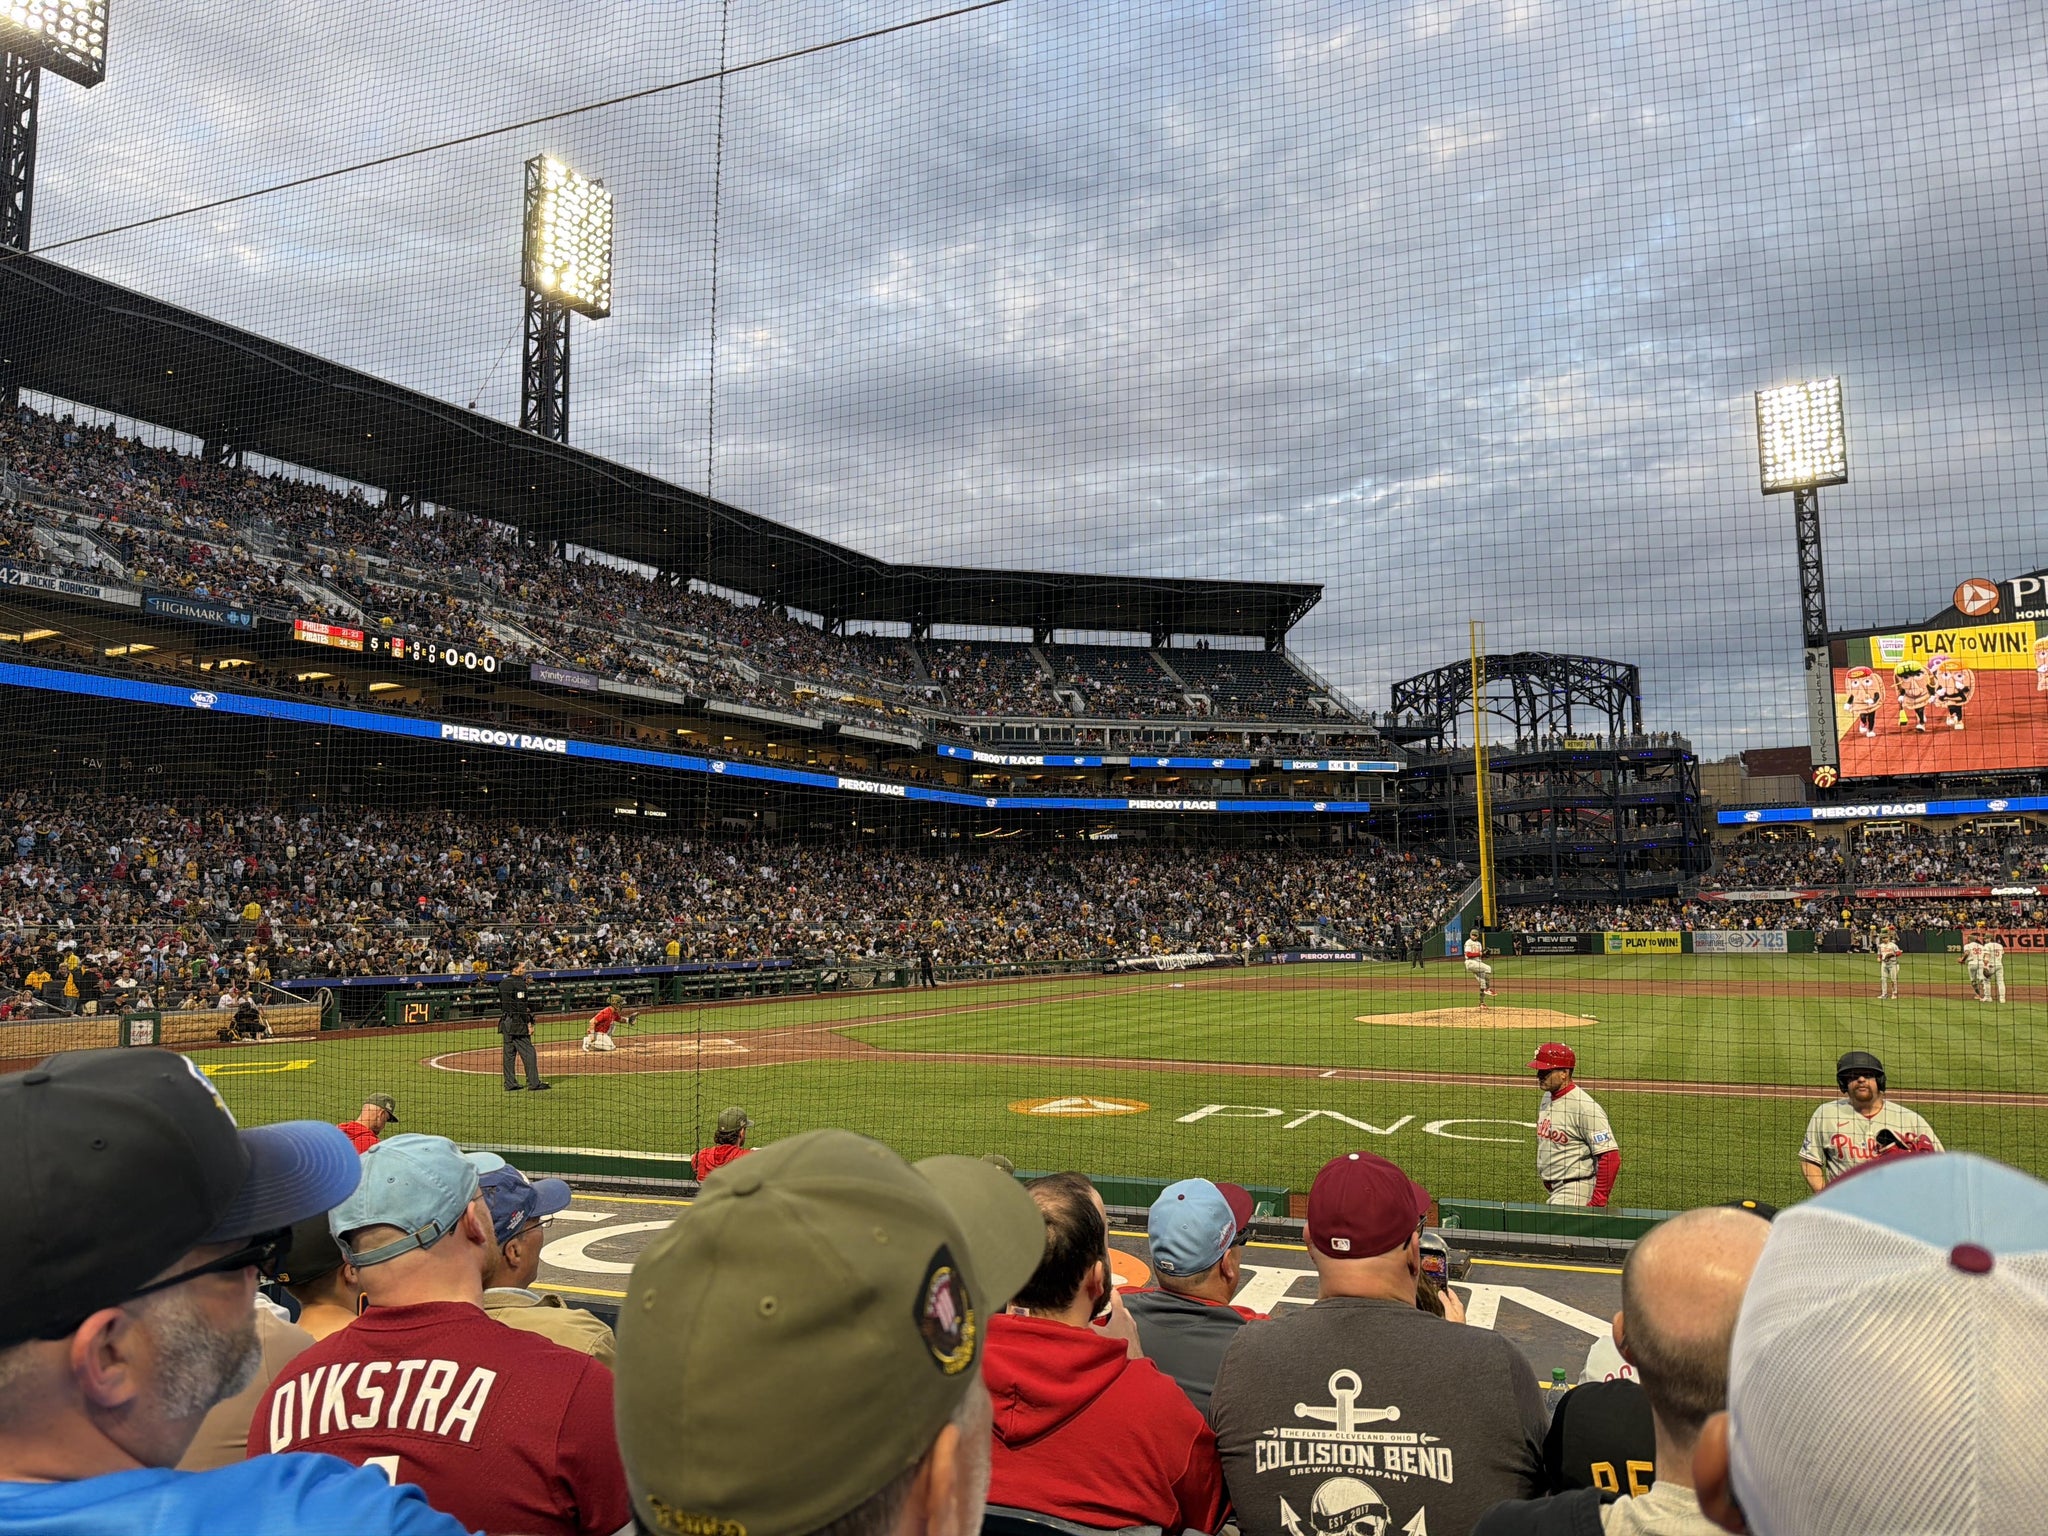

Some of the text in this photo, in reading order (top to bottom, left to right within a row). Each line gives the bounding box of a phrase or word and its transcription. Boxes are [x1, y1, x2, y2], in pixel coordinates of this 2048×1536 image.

[26, 575, 100, 597] JACKIE ROBINSON
[155, 600, 224, 623] HIGHMARK
[2016, 609, 2048, 620] HOM
[302, 621, 329, 634] PHILLIES
[302, 631, 329, 645] PIRATES
[370, 638, 378, 648] 5
[396, 638, 401, 647] 3
[414, 642, 420, 650] 6
[429, 644, 436, 653] 0
[1911, 632, 2028, 654] PLAY TO WIN!
[394, 648, 435, 663] 6 6 0
[446, 649, 458, 666] 0
[464, 652, 476, 669] 0
[484, 656, 496, 672] 0
[540, 670, 590, 686] xfinity mobile
[442, 724, 566, 753] PIEROGY RACE
[972, 751, 1044, 765] PIEROGY RACE
[1292, 760, 1318, 769] KOPPERS
[838, 778, 904, 796] PIEROGY RACE
[1128, 800, 1217, 810] PIEROGY RACE
[1812, 803, 1926, 818] PIEROGY RACE
[1626, 938, 1648, 948] PLAY
[1658, 938, 1678, 947] WIN!
[1761, 932, 1784, 948] 125
[1175, 1104, 1537, 1143] PNC
[1594, 1132, 1610, 1143] IBX
[270, 1359, 497, 1454] DYKSTRA
[1302, 1431, 1326, 1439] FLATS
[1256, 1440, 1454, 1484] COLLISION BEND
[1290, 1466, 1409, 1483] BREWING COMPANY
[1328, 1504, 1370, 1530] EST. 2017
